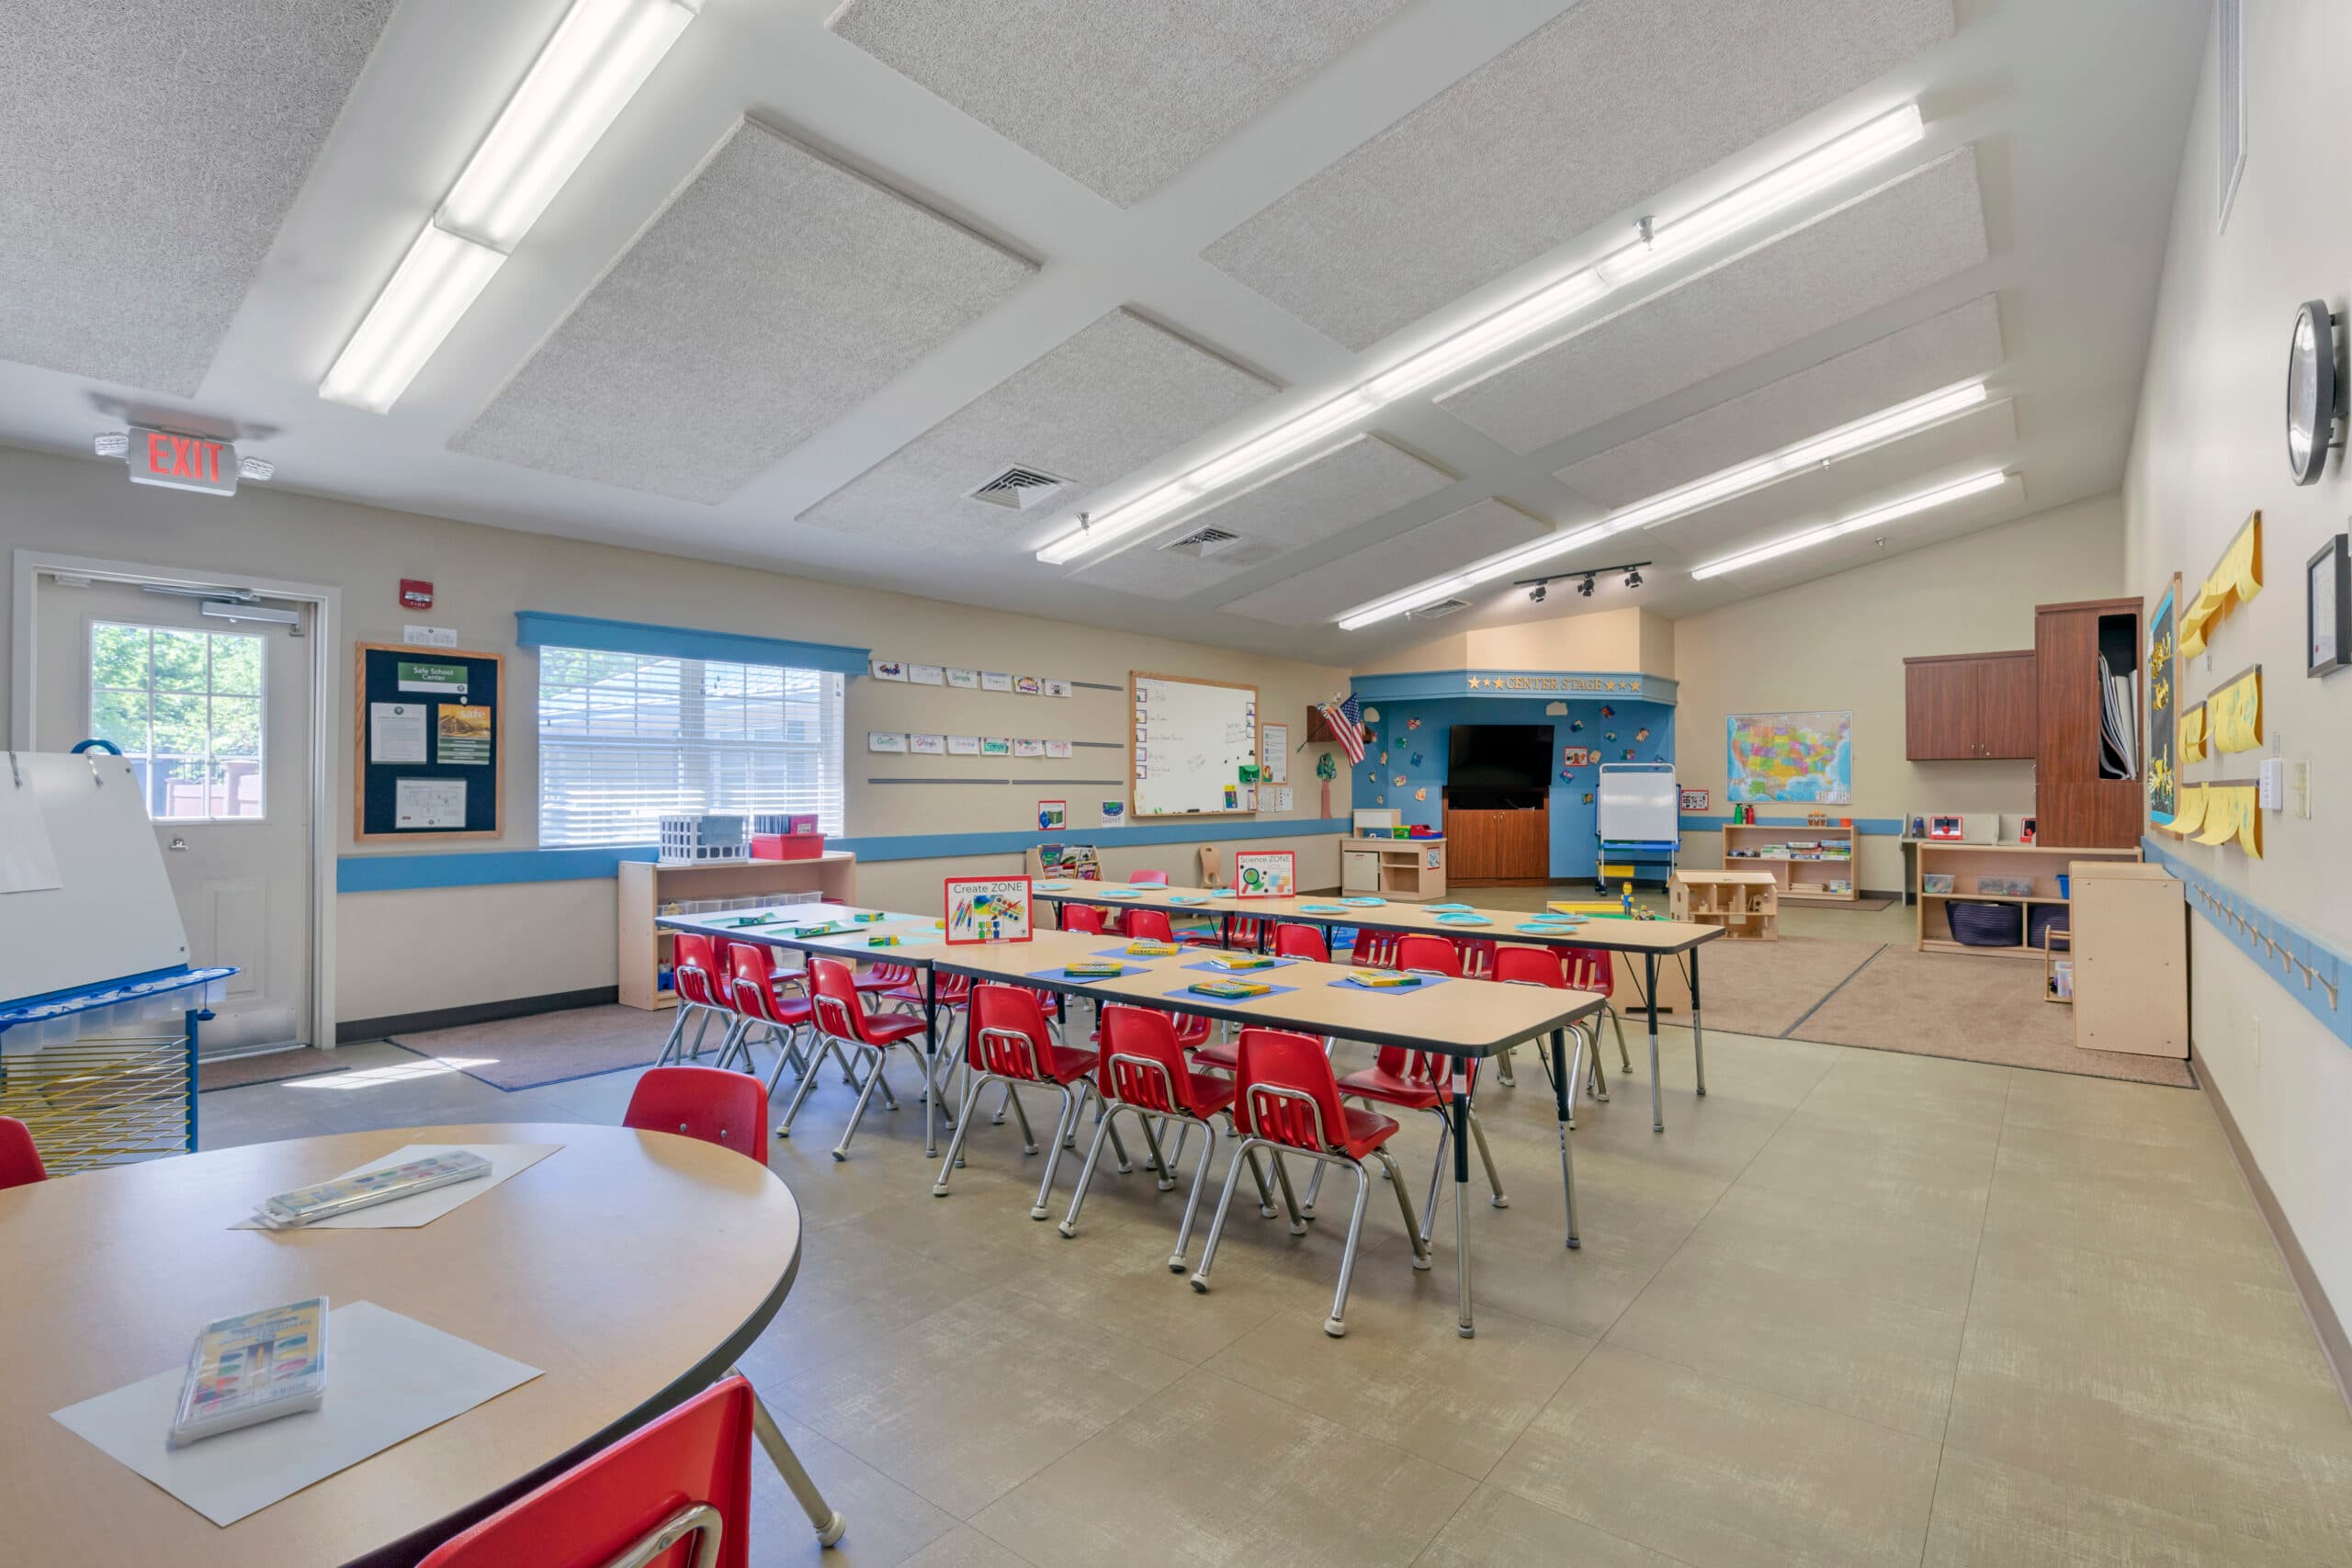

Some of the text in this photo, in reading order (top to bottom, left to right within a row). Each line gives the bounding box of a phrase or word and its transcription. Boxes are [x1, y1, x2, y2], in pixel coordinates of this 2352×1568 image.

[146, 432, 223, 482] EXIT
[413, 667, 454, 676] Safe School
[1505, 677, 1603, 692] CENTER STAGE
[459, 708, 486, 719] safe
[954, 882, 1023, 894] Create ZONE
